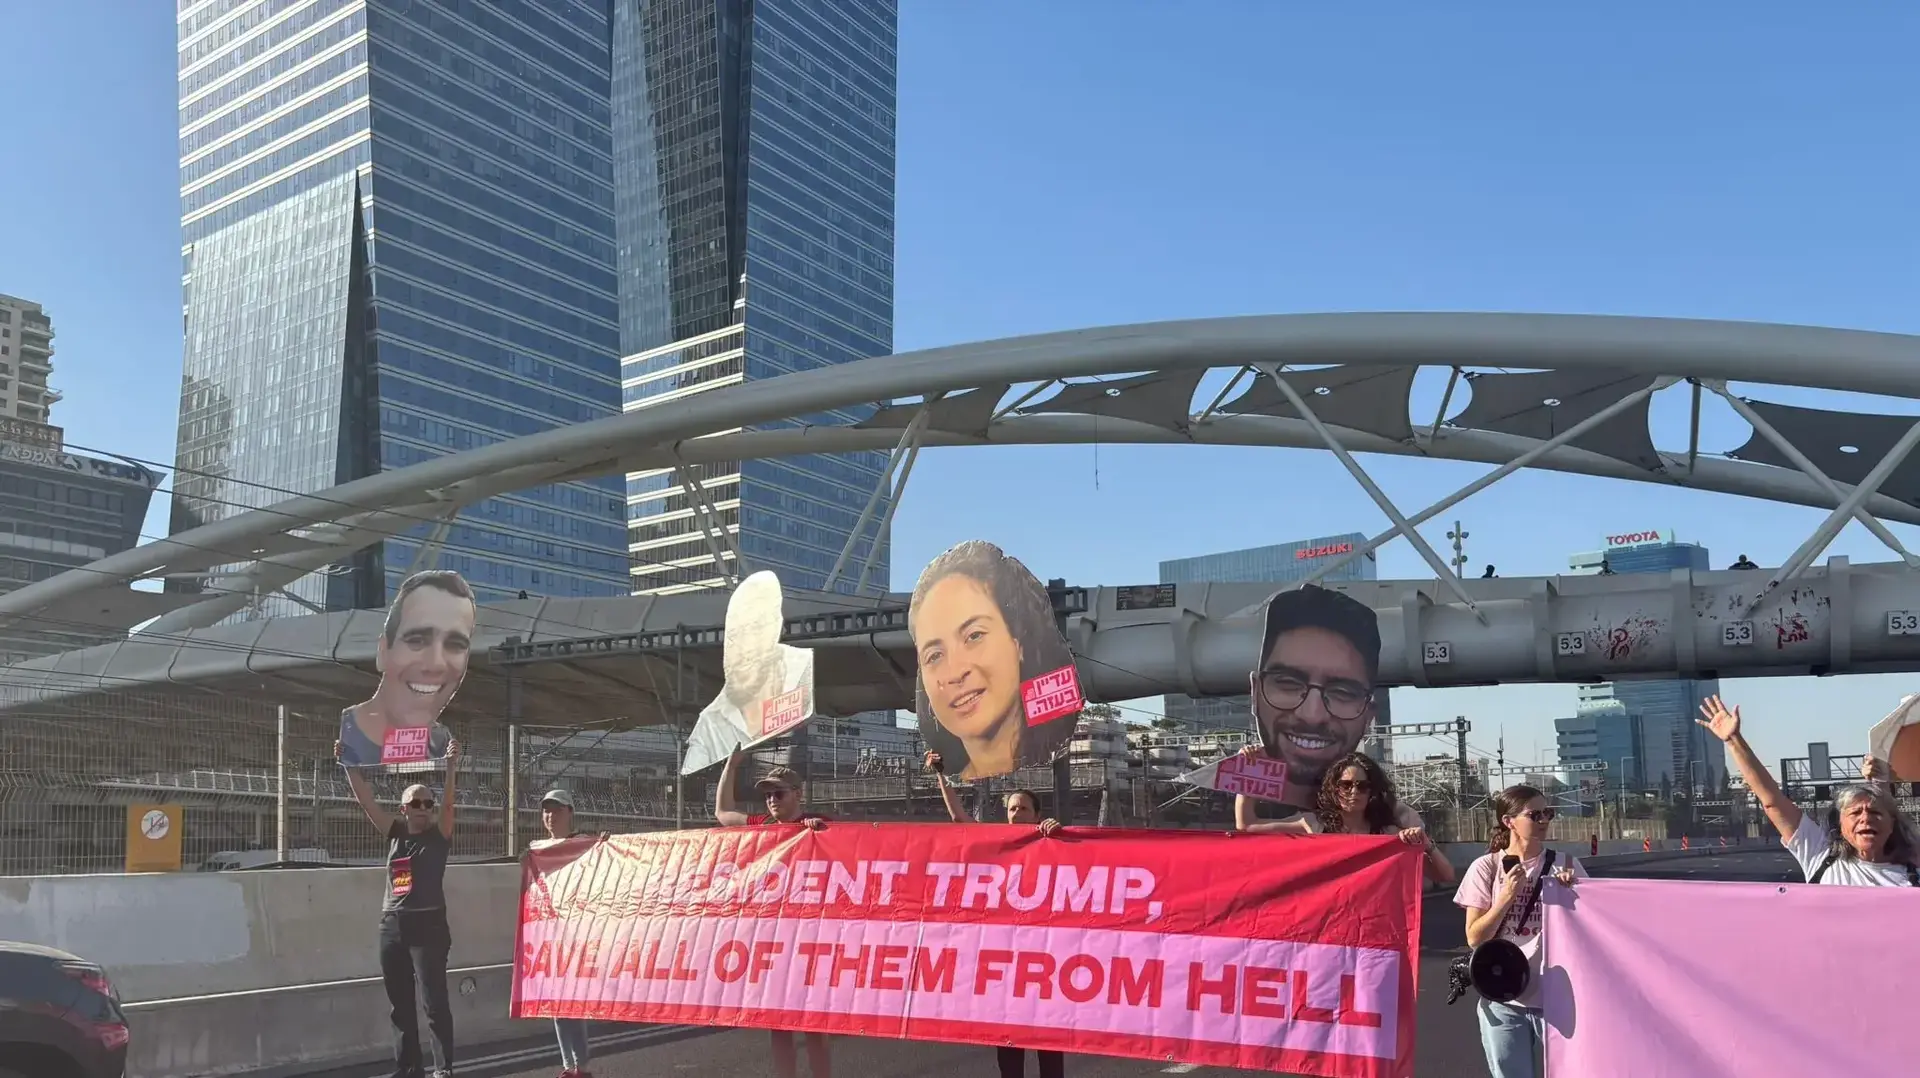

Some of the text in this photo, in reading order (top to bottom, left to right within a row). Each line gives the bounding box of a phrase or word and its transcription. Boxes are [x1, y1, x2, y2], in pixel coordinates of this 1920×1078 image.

[1606, 530, 1660, 546] TOYOTA
[1296, 543, 1353, 559] SUZUKI
[1891, 615, 1918, 630] 5.3
[1725, 626, 1750, 641] 5.3
[1560, 637, 1583, 650] 5.3
[1427, 646, 1447, 659] 5.3
[1036, 669, 1073, 695] עדיין
[774, 690, 800, 713] עדיין
[1033, 688, 1077, 715] בעזה.
[767, 707, 801, 730] בעזה.
[397, 729, 426, 742] עדיין
[387, 744, 424, 757] בעזה.
[925, 861, 1163, 924] TRUMP,
[522, 938, 1382, 1029] SAVE ALL OF THEM FROM HELL
